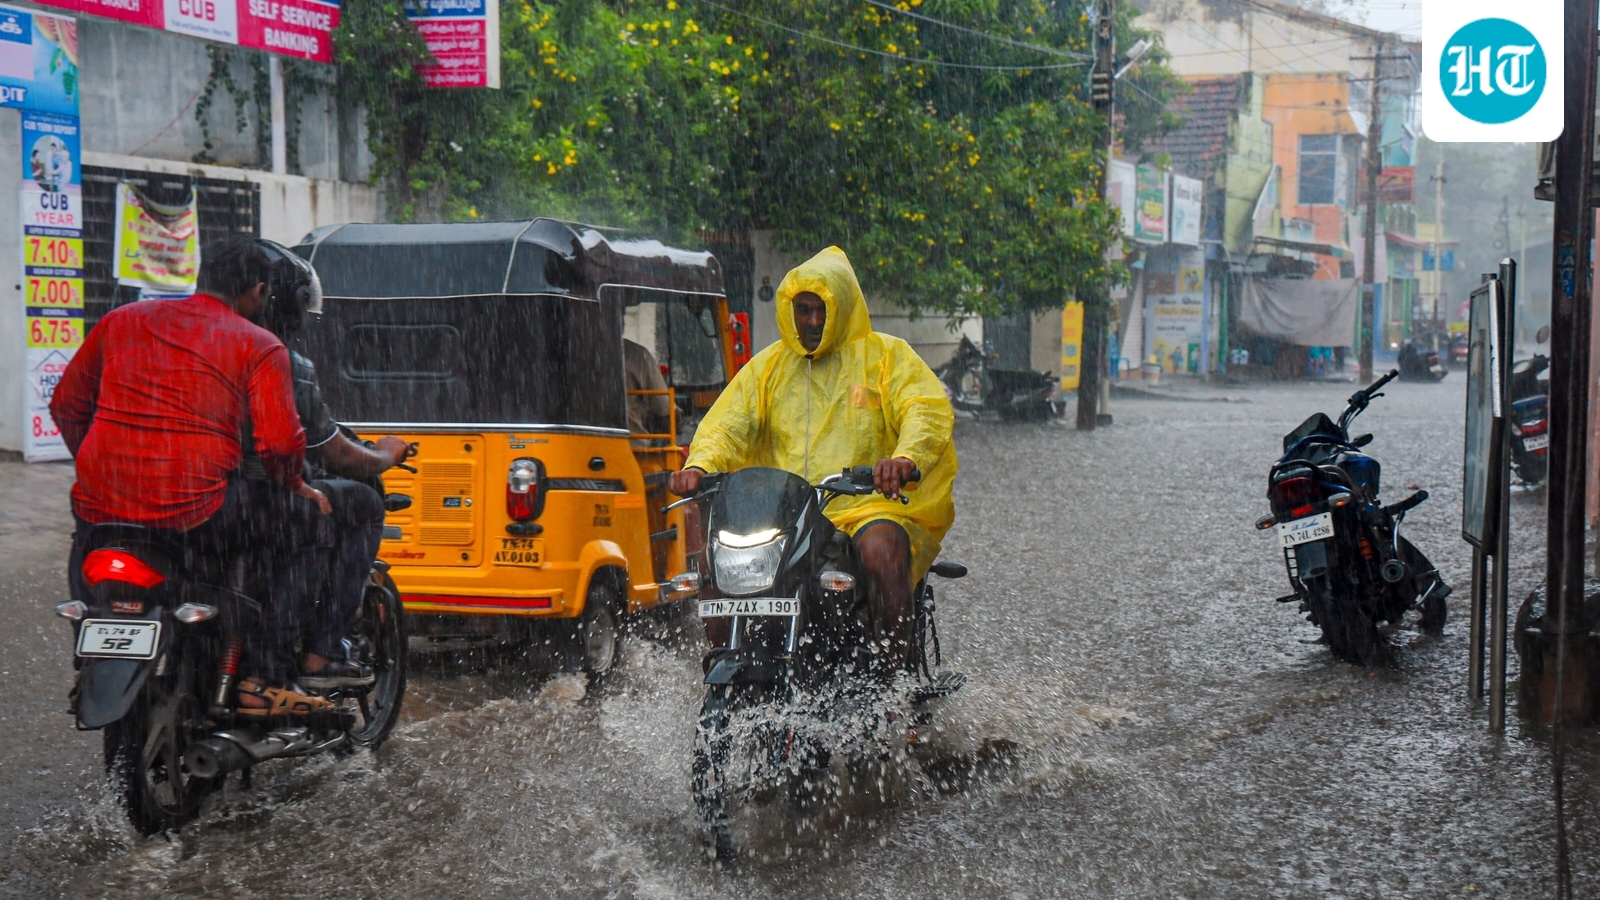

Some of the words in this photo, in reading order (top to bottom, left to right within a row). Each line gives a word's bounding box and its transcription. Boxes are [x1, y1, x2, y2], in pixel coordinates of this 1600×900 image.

[178, 0, 215, 22] CUB
[248, 0, 279, 20] SELF
[281, 5, 331, 31] SERVICE
[264, 27, 319, 54] BANKING
[40, 193, 69, 211] CUB
[41, 308, 69, 316] GENERAL
[1283, 534, 1295, 544] TN
[1313, 525, 1330, 536] 4286
[710, 602, 722, 614] TN
[728, 602, 757, 613] 74AX
[768, 601, 798, 613] 1901
[112, 627, 126, 635] 74
[101, 637, 133, 650] 52
